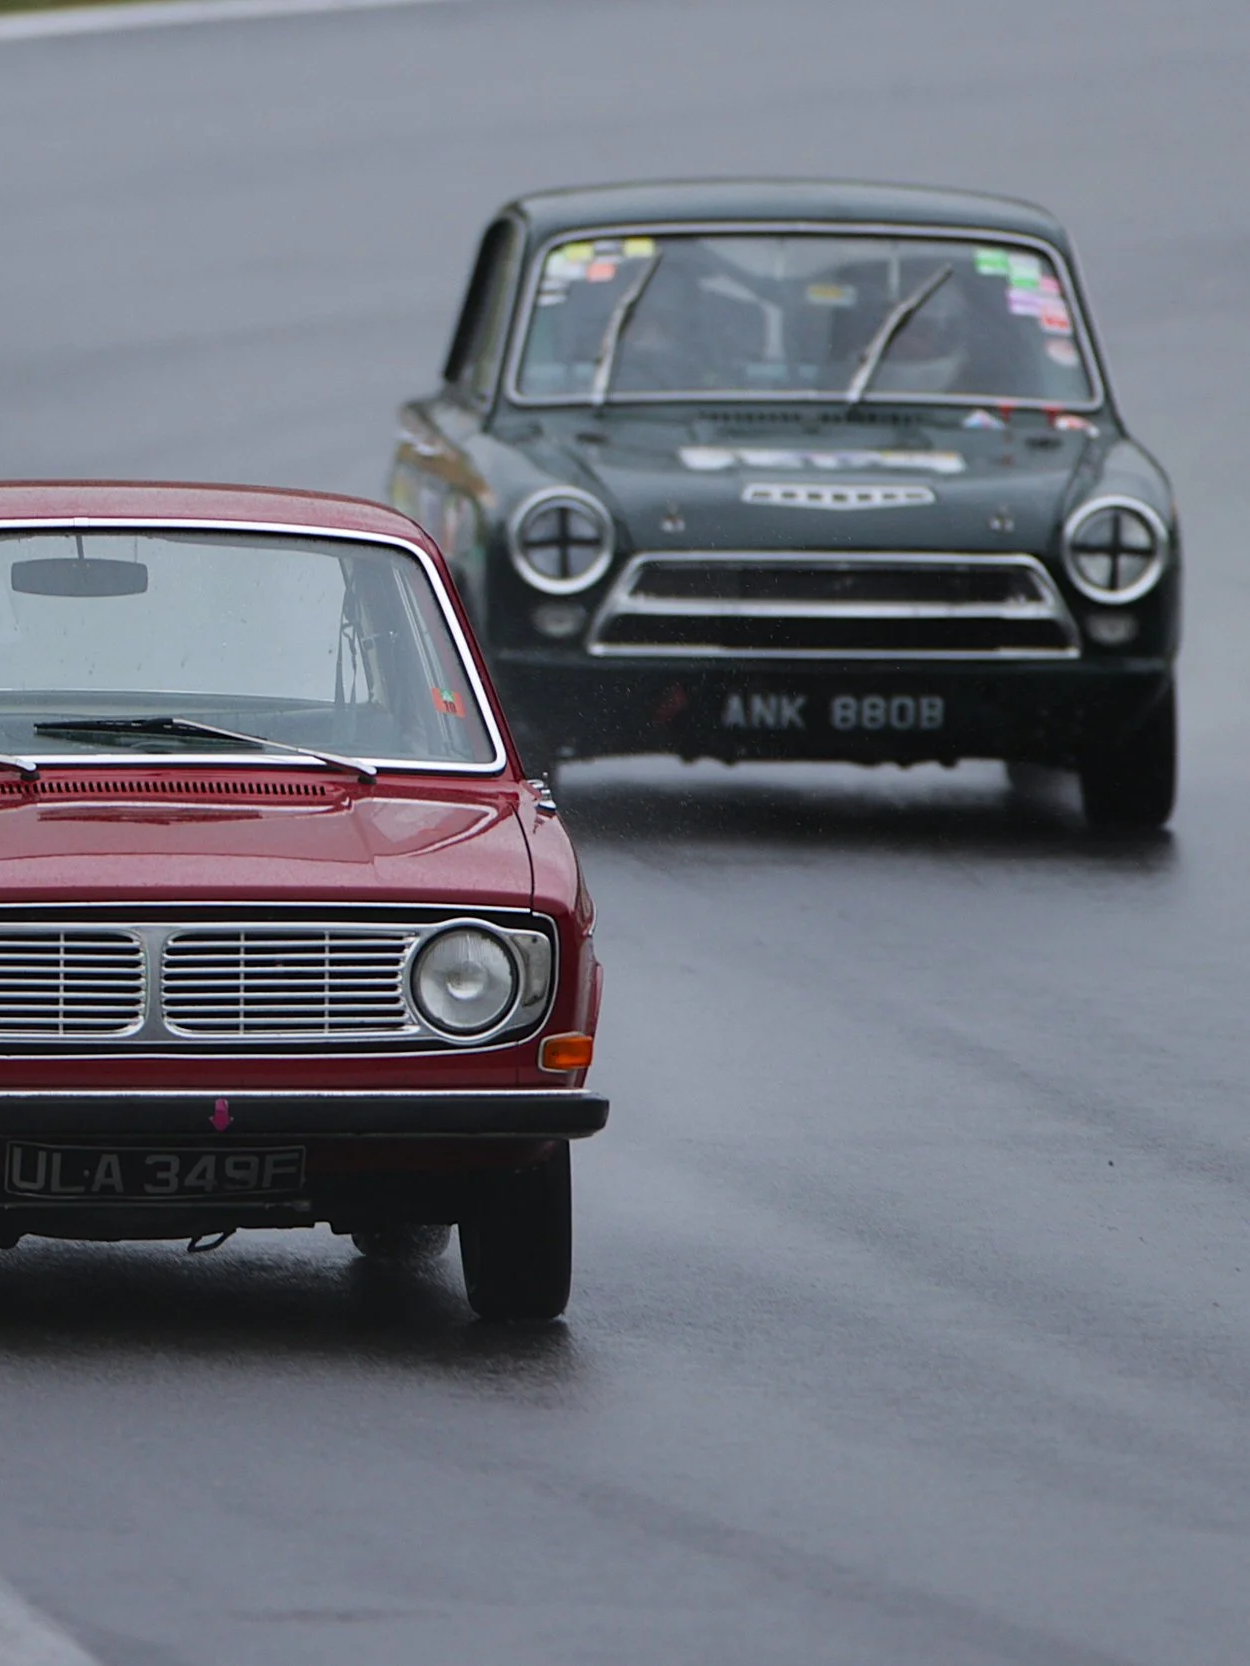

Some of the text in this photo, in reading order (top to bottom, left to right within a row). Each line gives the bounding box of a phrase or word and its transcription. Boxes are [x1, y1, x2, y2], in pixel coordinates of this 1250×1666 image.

[722, 693, 947, 730] ANK 880B
[143, 1152, 301, 1194] 349F
